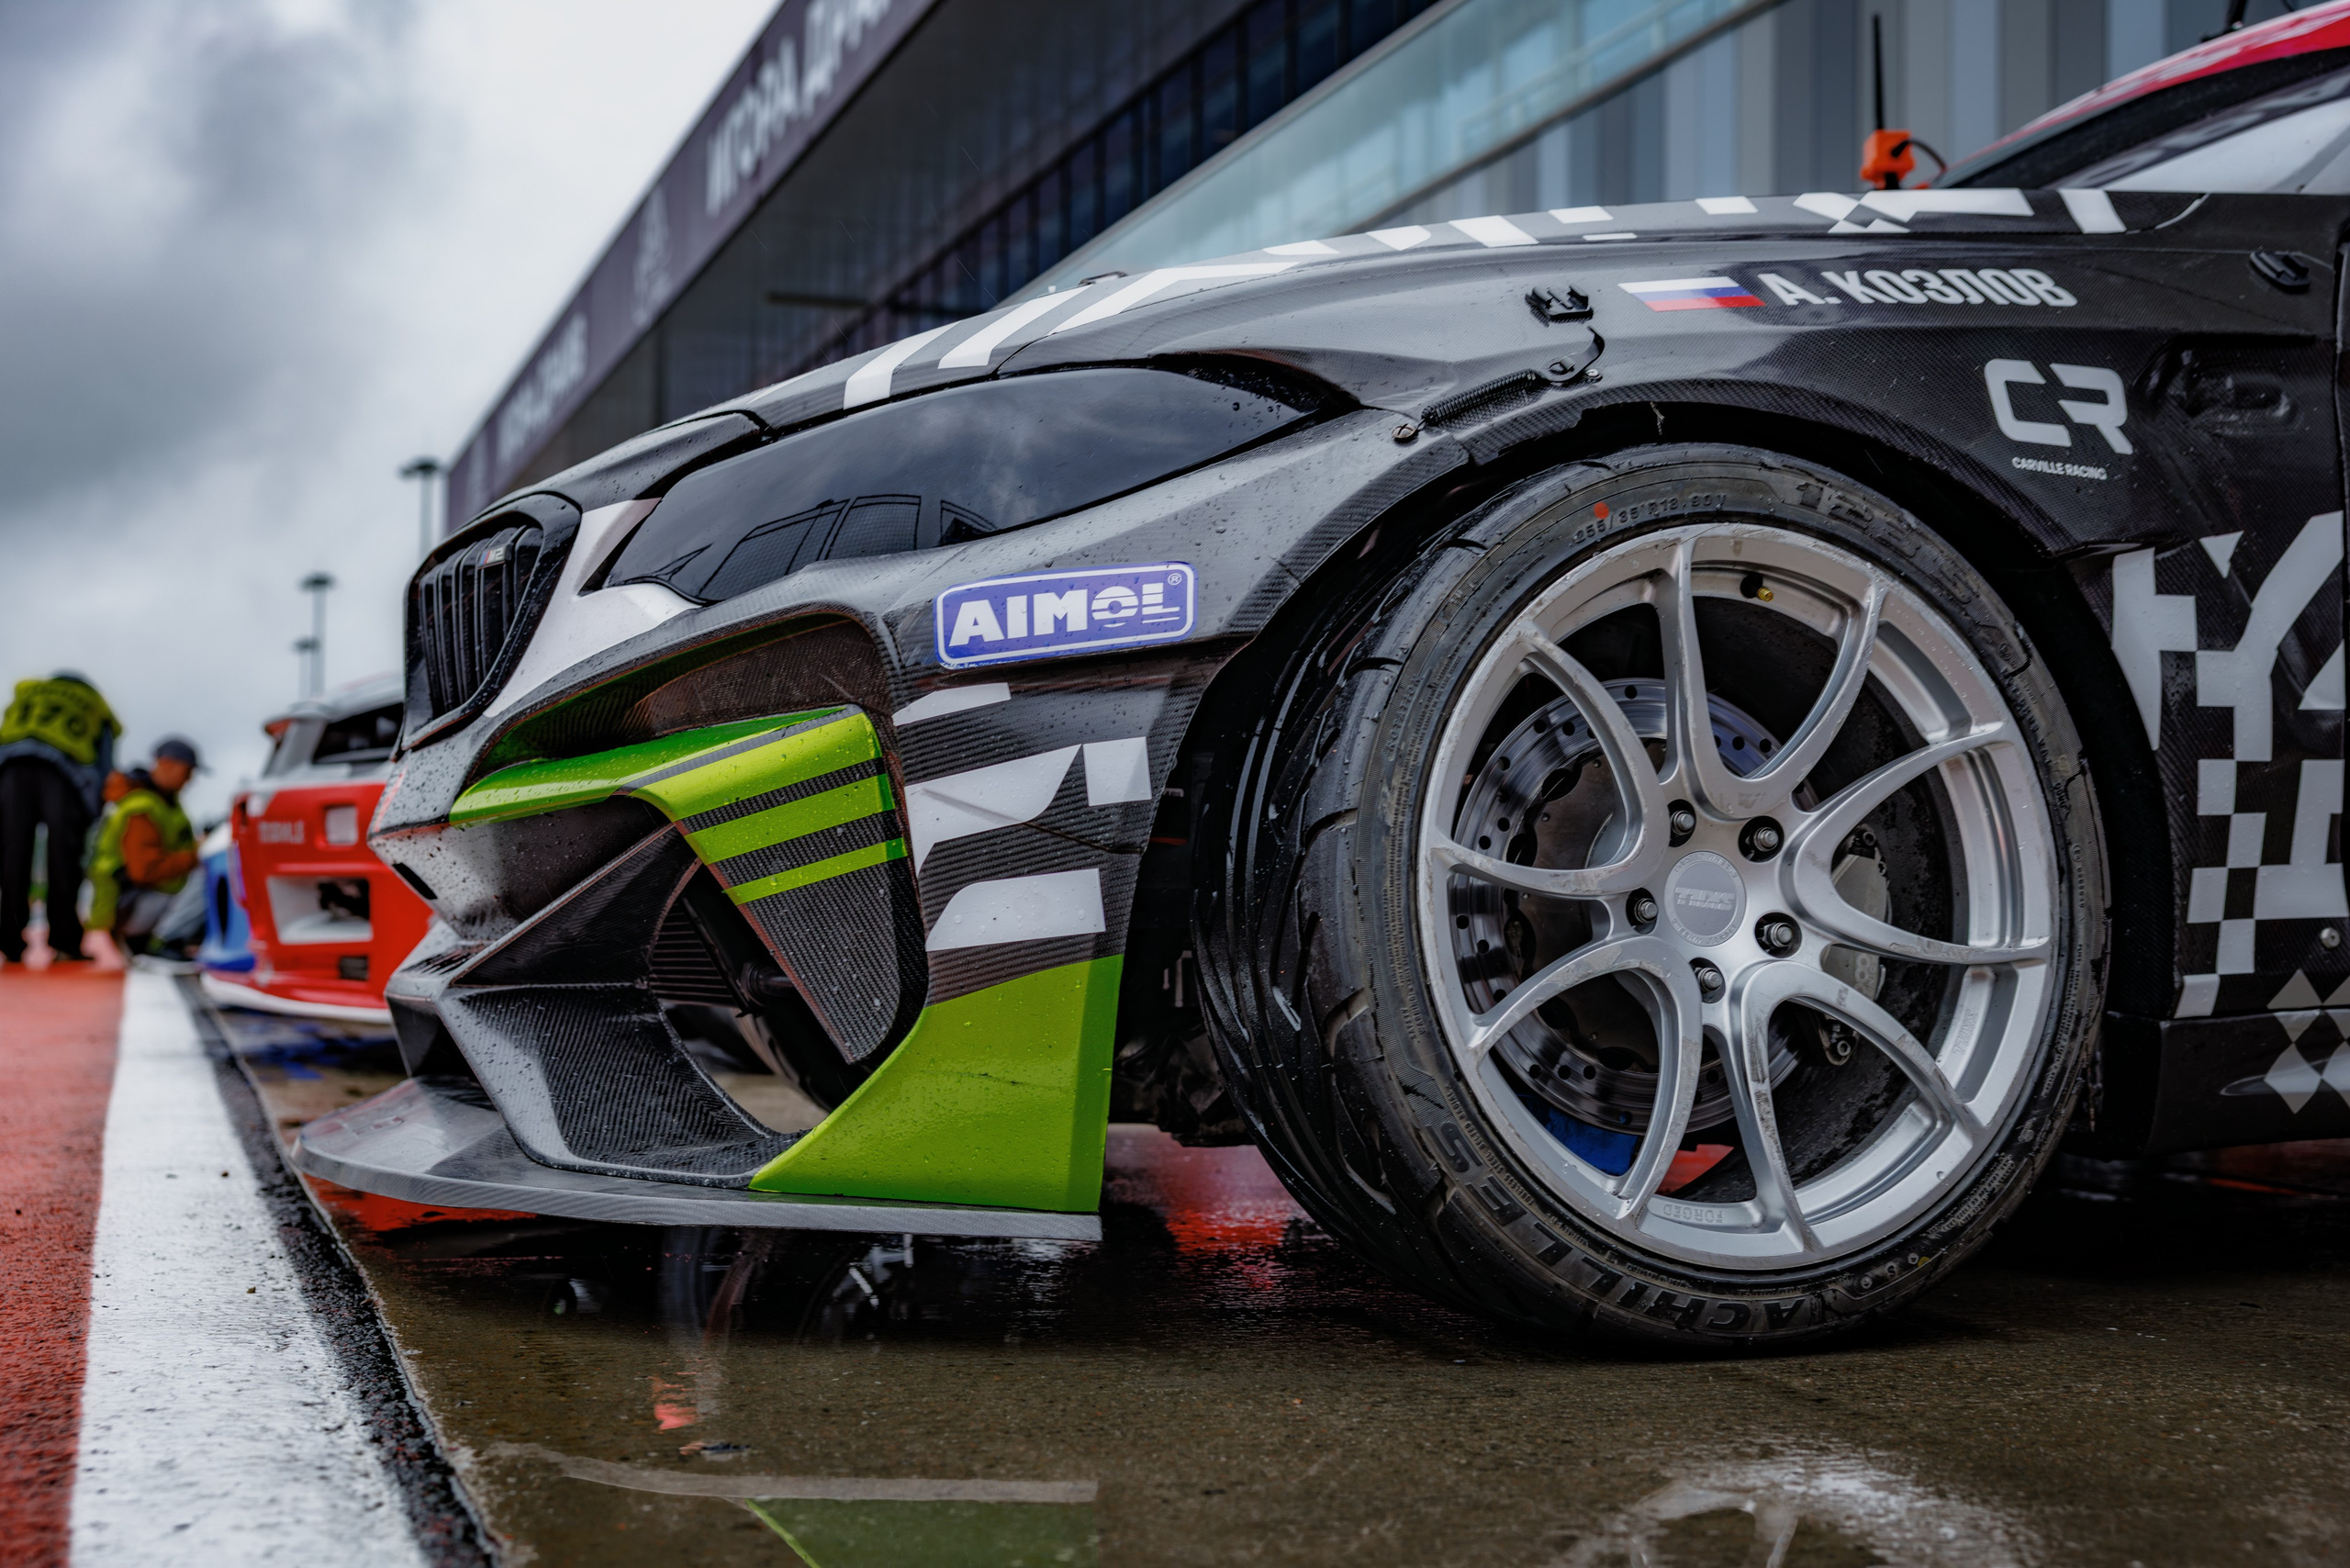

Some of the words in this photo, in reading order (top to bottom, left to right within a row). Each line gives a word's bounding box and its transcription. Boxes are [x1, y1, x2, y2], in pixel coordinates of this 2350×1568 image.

[1984, 358, 2133, 454] CR
[2011, 456, 2065, 476] CARVILLE
[2065, 463, 2108, 480] RACING
[1463, 1121, 1486, 1150] BELTED
[1484, 1150, 1504, 1173] STEEL
[1503, 1171, 1535, 1206] TUBELESS
[1423, 1122, 1810, 1331] ACHILLES
[1662, 1204, 1724, 1224] FORGED
